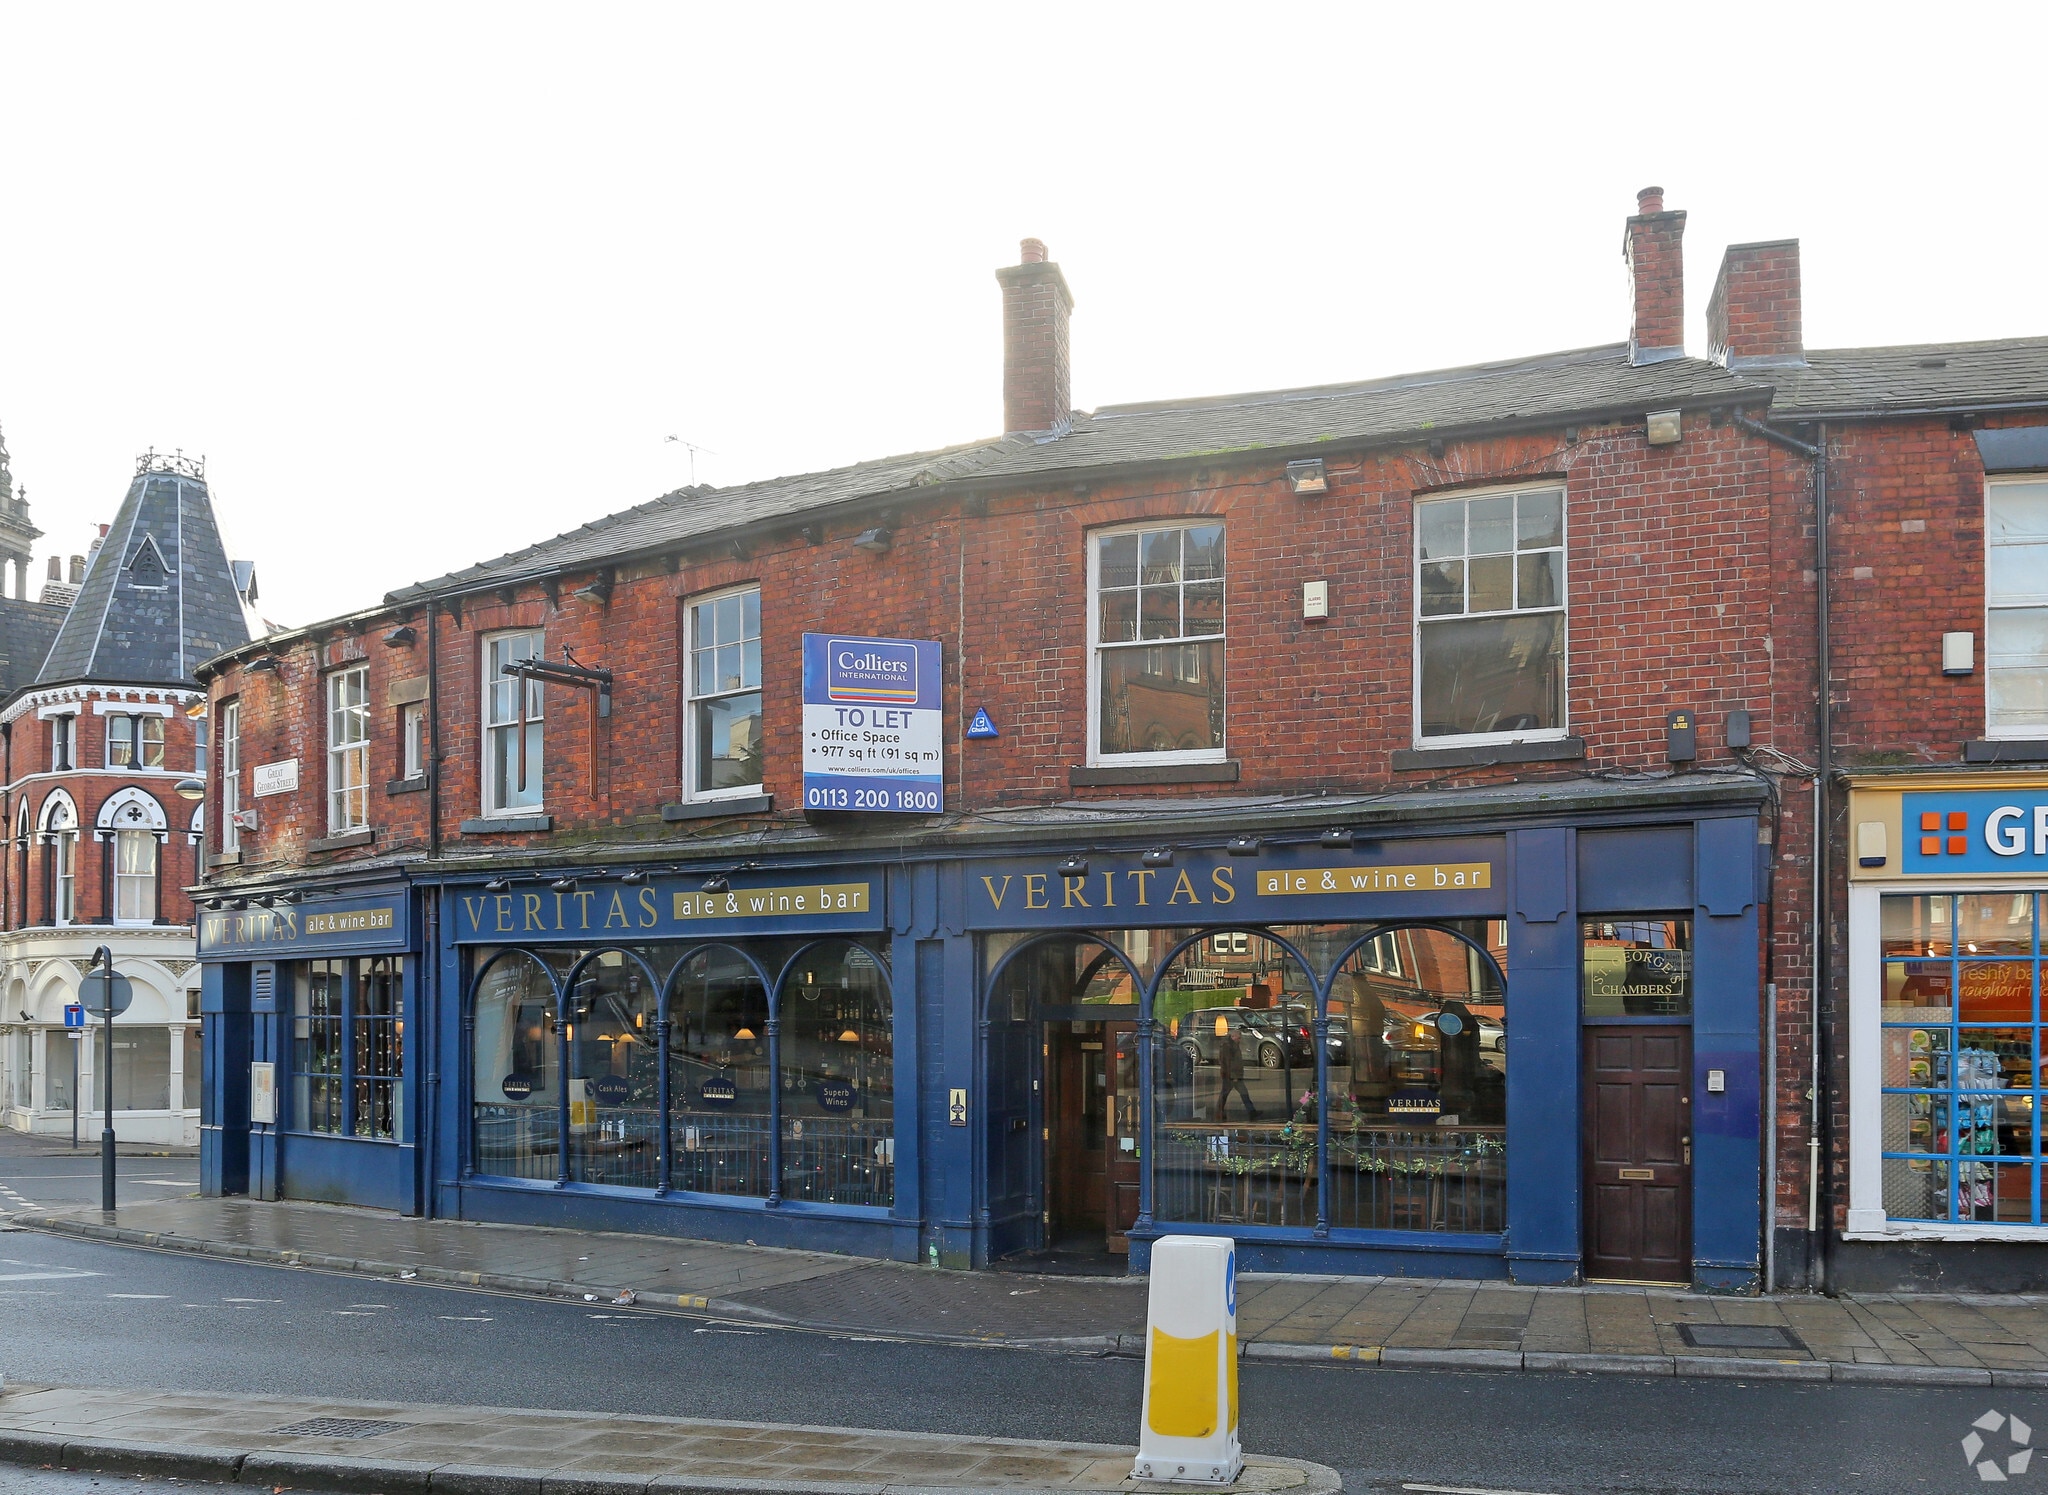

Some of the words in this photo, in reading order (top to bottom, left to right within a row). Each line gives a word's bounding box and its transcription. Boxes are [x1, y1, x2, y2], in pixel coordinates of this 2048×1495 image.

[838, 651, 908, 673] Colliers
[839, 671, 908, 682] INTERNATIONAL
[835, 708, 865, 727] TO
[873, 709, 913, 729] LET
[821, 729, 858, 742] Office
[863, 731, 900, 744] Space
[821, 746, 844, 758] 977
[848, 748, 863, 761] sq
[867, 747, 876, 759] ft
[881, 748, 900, 760] (91
[904, 750, 919, 762] sq
[922, 749, 940, 761] m)
[828, 766, 920, 775] www.colliers.com/uk/offices
[808, 787, 848, 807] 0113
[854, 789, 890, 808] 200
[895, 790, 938, 809] 1800
[980, 865, 1236, 911] VERITAS
[1267, 873, 1307, 892] ale
[1320, 870, 1337, 890] &
[1350, 870, 1416, 889] wine
[1434, 867, 1481, 887] bar
[462, 887, 658, 933] VERITAS
[682, 894, 715, 916] ale
[725, 892, 740, 914] &
[750, 891, 806, 912] wine
[820, 888, 861, 909] bar
[206, 911, 298, 944] VERITAS
[308, 916, 324, 932] ale
[328, 915, 336, 930] &
[339, 914, 365, 928] wine
[370, 911, 390, 926] bar
[1601, 984, 1672, 995] CHAMBERS
[598, 1084, 613, 1093] Cask
[614, 1085, 628, 1093] Ales
[703, 1086, 735, 1094] VERITAS
[823, 1088, 850, 1099] Superb
[825, 1098, 848, 1106] Wines
[1389, 1099, 1441, 1107] VERITAS
